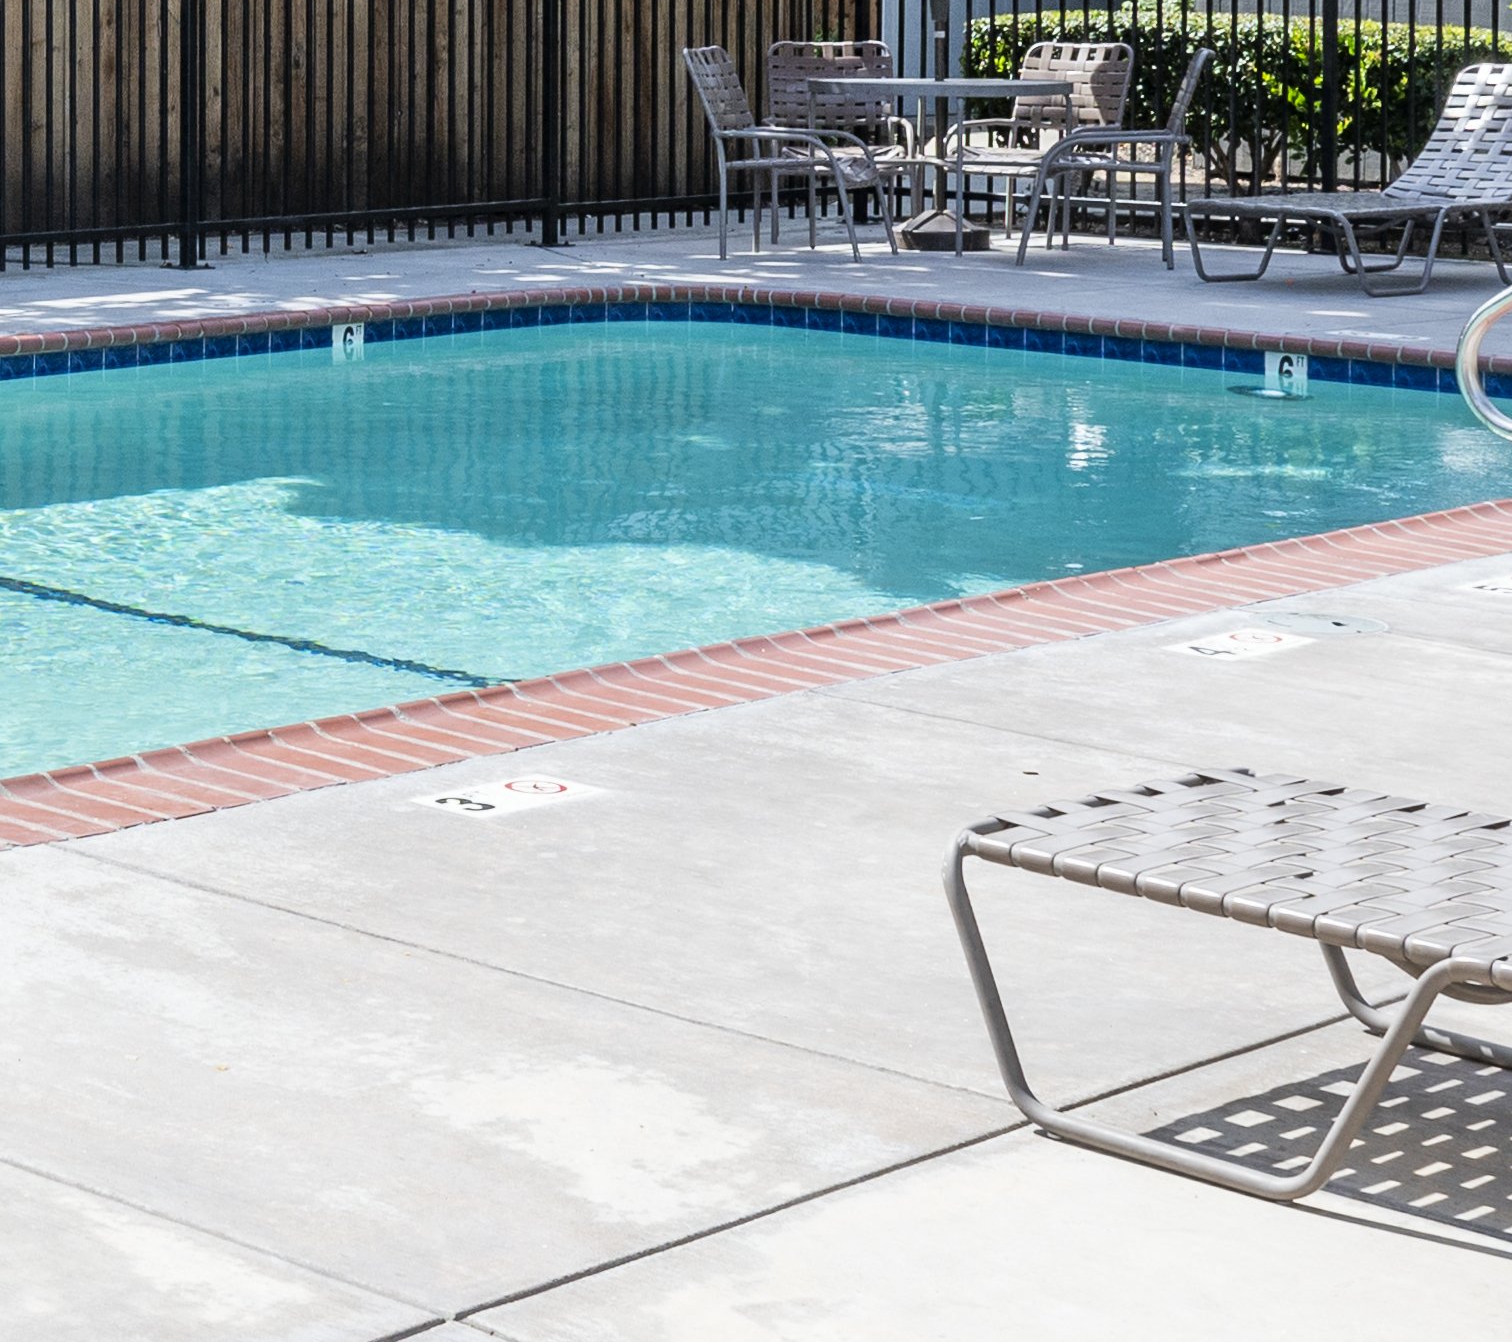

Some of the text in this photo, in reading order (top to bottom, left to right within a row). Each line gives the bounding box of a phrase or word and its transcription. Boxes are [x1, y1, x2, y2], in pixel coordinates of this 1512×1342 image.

[1279, 355, 1305, 378] 6 FT
[1188, 646, 1236, 656] 4
[435, 797, 496, 811] 3
